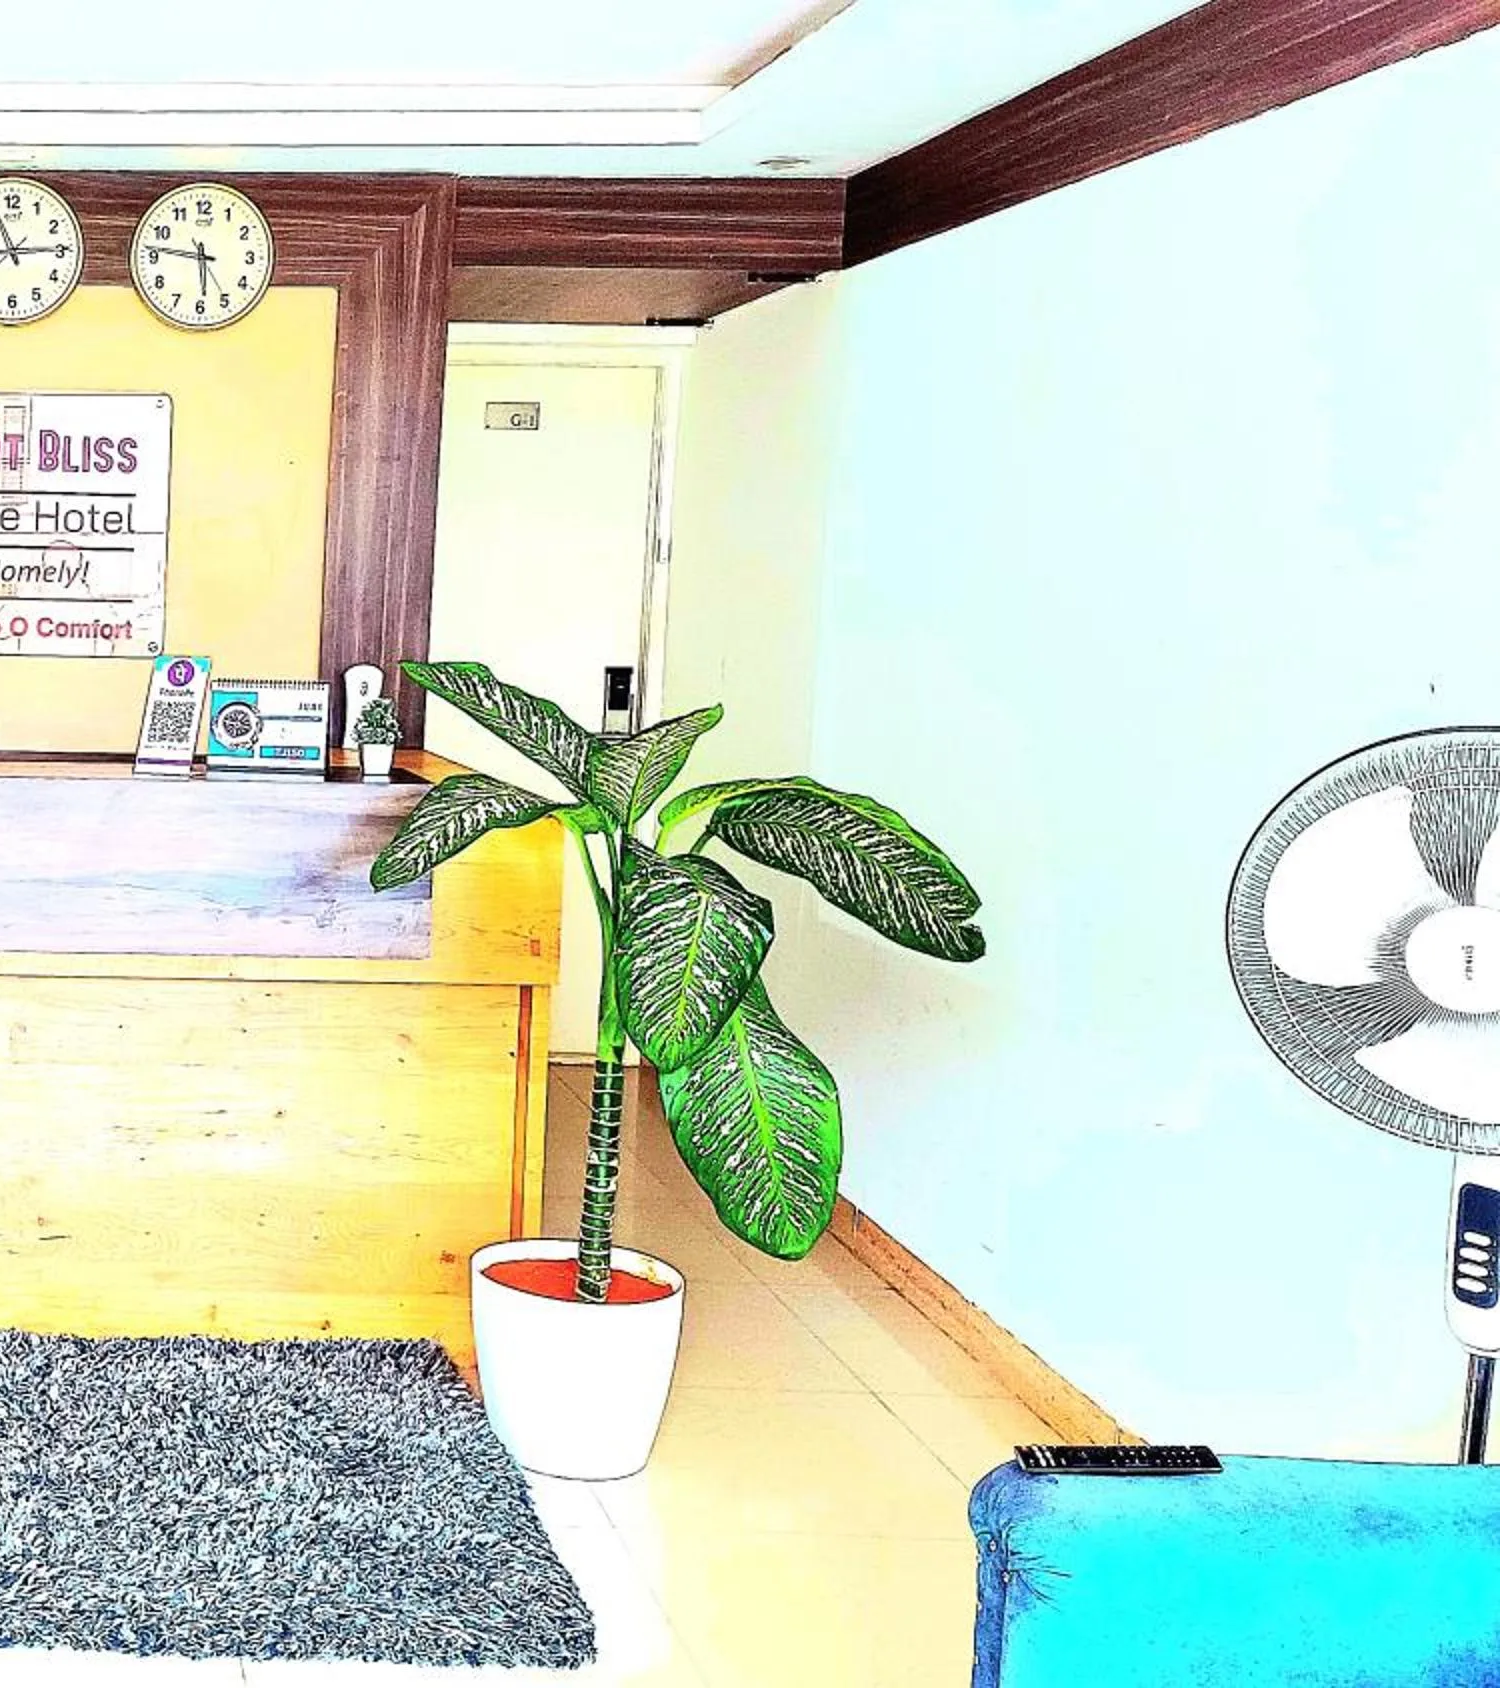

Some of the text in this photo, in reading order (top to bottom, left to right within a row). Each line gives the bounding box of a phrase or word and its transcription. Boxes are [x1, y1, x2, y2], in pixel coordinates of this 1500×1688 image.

[3, 193, 21, 210] 12
[32, 201, 41, 216] 1
[195, 199, 213, 215] 12
[171, 206, 187, 222] 11
[223, 207, 231, 222] 1
[48, 219, 59, 235] 2
[153, 225, 171, 241] 10
[239, 225, 250, 241] 2
[148, 249, 159, 265] 9
[244, 250, 255, 265] 3
[48, 268, 59, 284] 4
[154, 274, 165, 289] 8
[237, 275, 248, 290] 4
[6, 293, 18, 309] 6
[31, 287, 42, 302] 5
[171, 293, 183, 308] 7
[219, 293, 230, 309] 5
[194, 299, 206, 315] 6
[38, 428, 139, 474] BLISS
[35, 500, 137, 534] Hotel
[9, 616, 29, 637] O
[36, 617, 133, 640] Comfort
